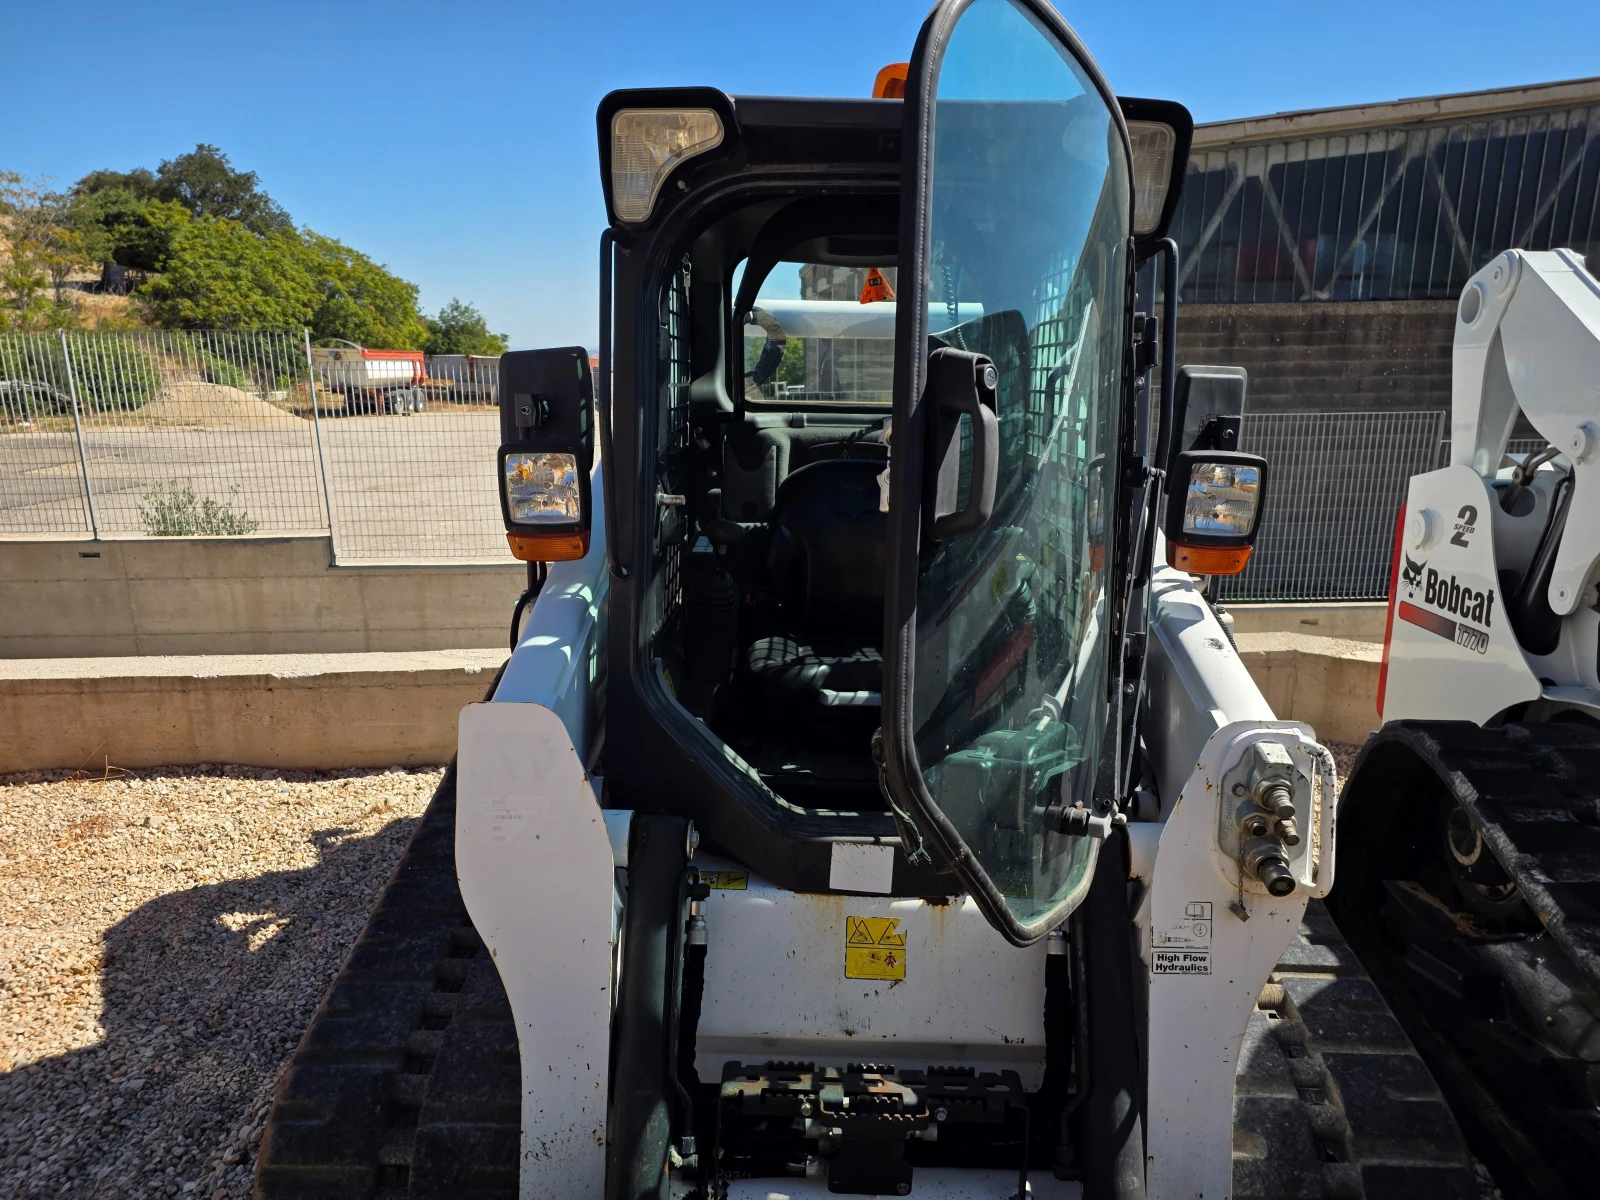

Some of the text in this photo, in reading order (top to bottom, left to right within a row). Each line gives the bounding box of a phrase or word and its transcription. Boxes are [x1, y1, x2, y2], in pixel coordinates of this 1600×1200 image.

[1450, 504, 1478, 549] 2
[1453, 523, 1475, 534] SPEED
[1424, 567, 1494, 628] Bobcat
[1456, 622, 1490, 655] T770
[1155, 963, 1209, 972] Hydraulics
[1157, 953, 1207, 963] High Flow
